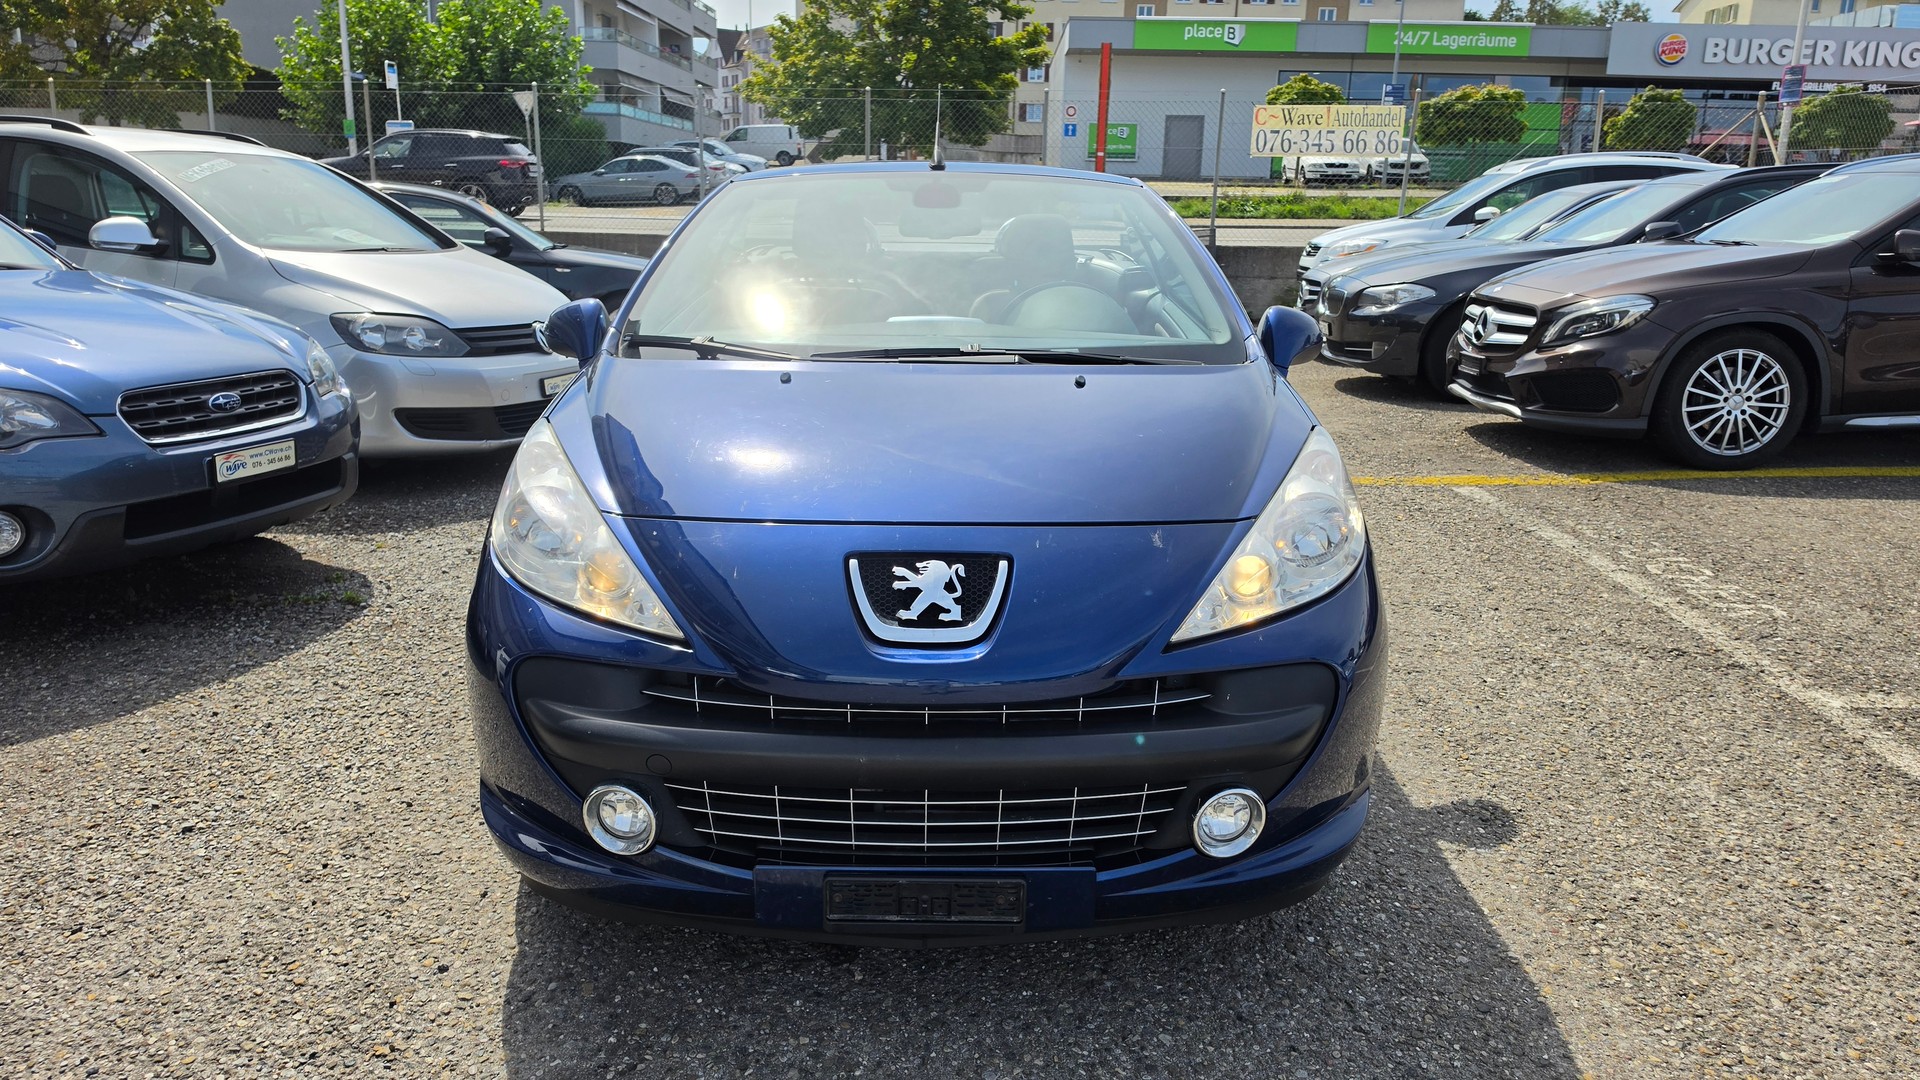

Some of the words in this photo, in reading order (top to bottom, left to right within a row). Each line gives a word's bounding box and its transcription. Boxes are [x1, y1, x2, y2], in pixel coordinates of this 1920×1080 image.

[1393, 31, 1430, 45] 24/7
[1432, 31, 1517, 50] Lagerräume
[1659, 45, 1687, 56] KING
[1703, 37, 1836, 66] BURGER
[1331, 107, 1403, 128] Autohandel
[1255, 129, 1336, 154] 076-345
[1343, 129, 1368, 155] 66
[1374, 129, 1400, 155] 86
[267, 457, 276, 465] 345
